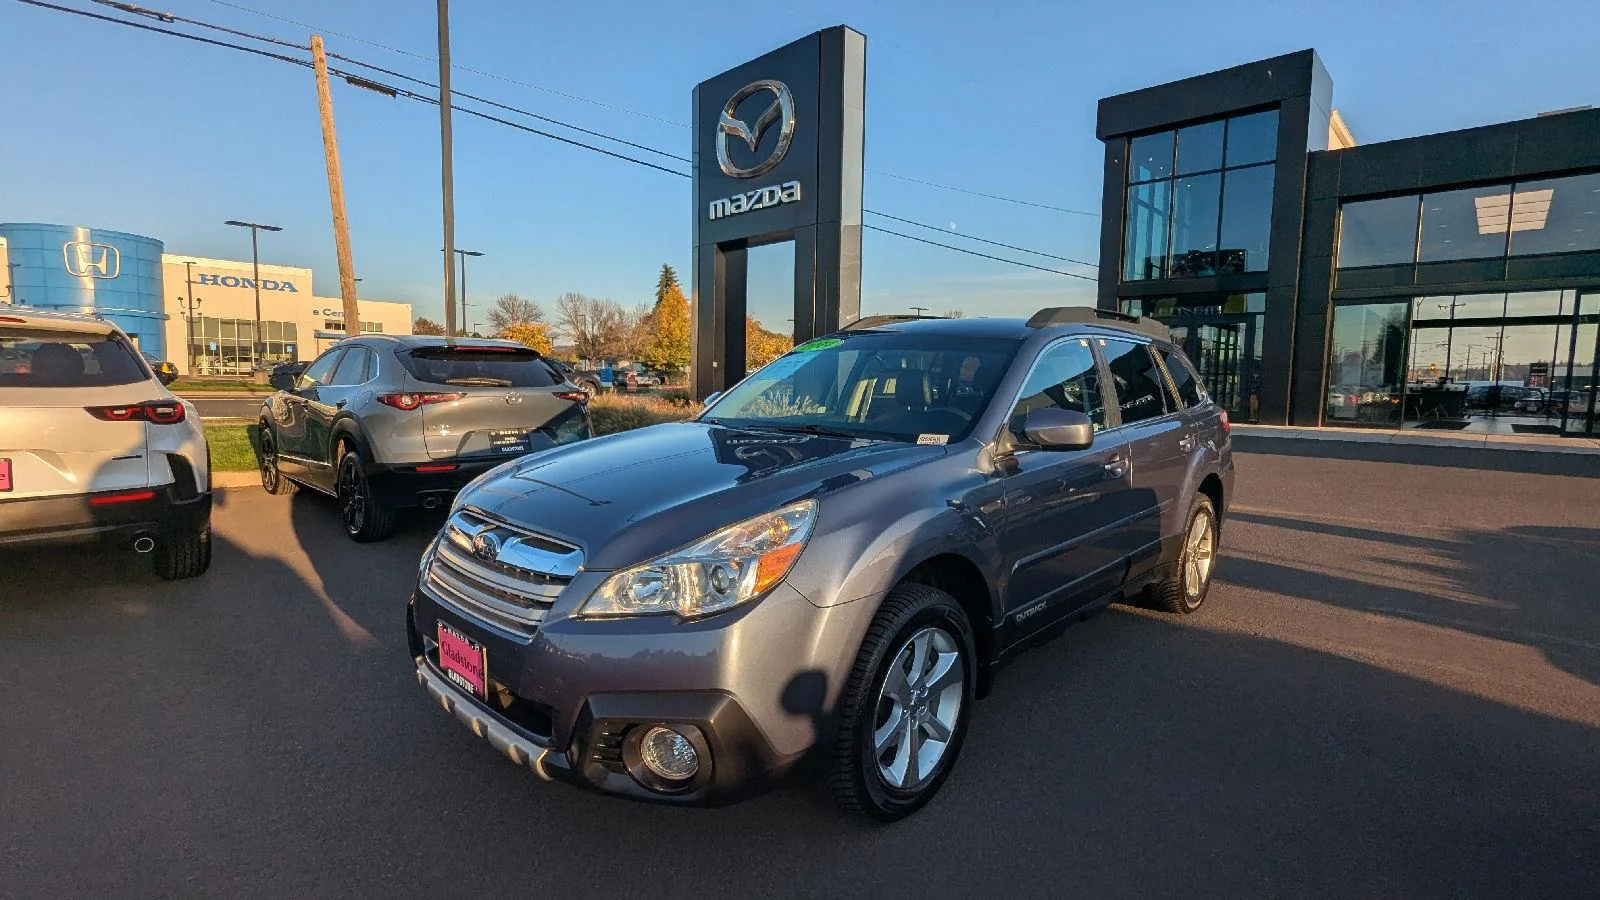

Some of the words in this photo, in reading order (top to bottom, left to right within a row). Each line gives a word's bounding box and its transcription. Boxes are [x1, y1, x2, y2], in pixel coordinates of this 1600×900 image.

[198, 273, 298, 292] HONDA
[1016, 601, 1048, 622] OUTBACK
[441, 640, 483, 680] Gladstone
[447, 668, 474, 694] GLADSTONE
